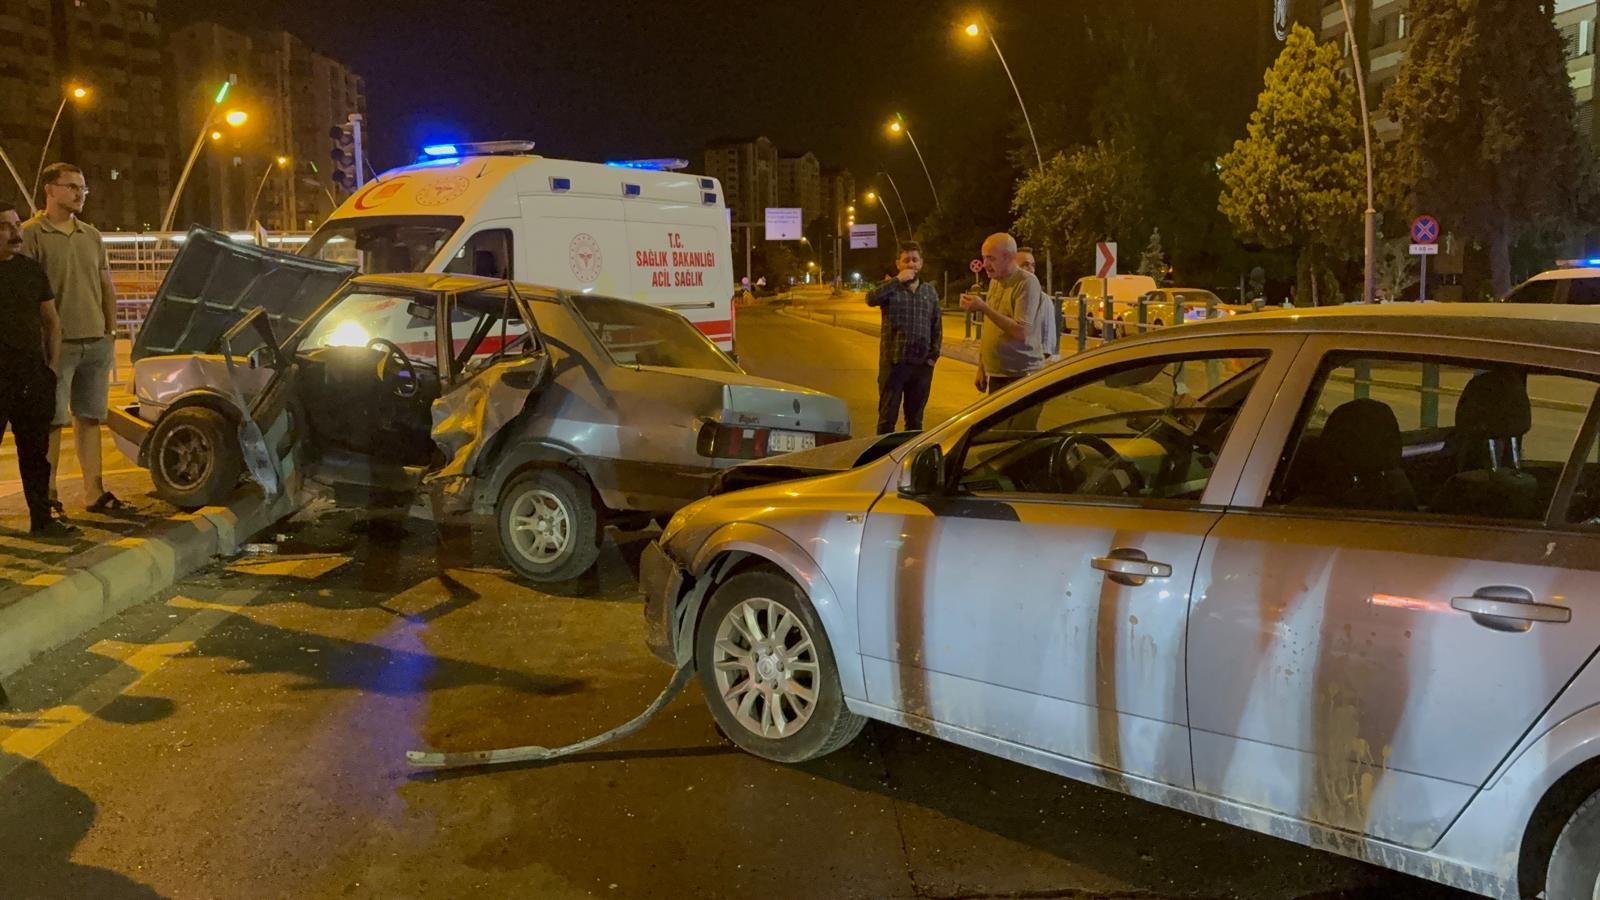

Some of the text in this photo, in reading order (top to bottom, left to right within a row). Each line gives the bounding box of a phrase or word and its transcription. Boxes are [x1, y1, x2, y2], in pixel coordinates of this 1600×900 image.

[668, 233, 684, 248] T.C.
[636, 249, 715, 267] SAĞLIK BAKANLIĞI
[652, 269, 704, 287] ACİL SAĞLIK
